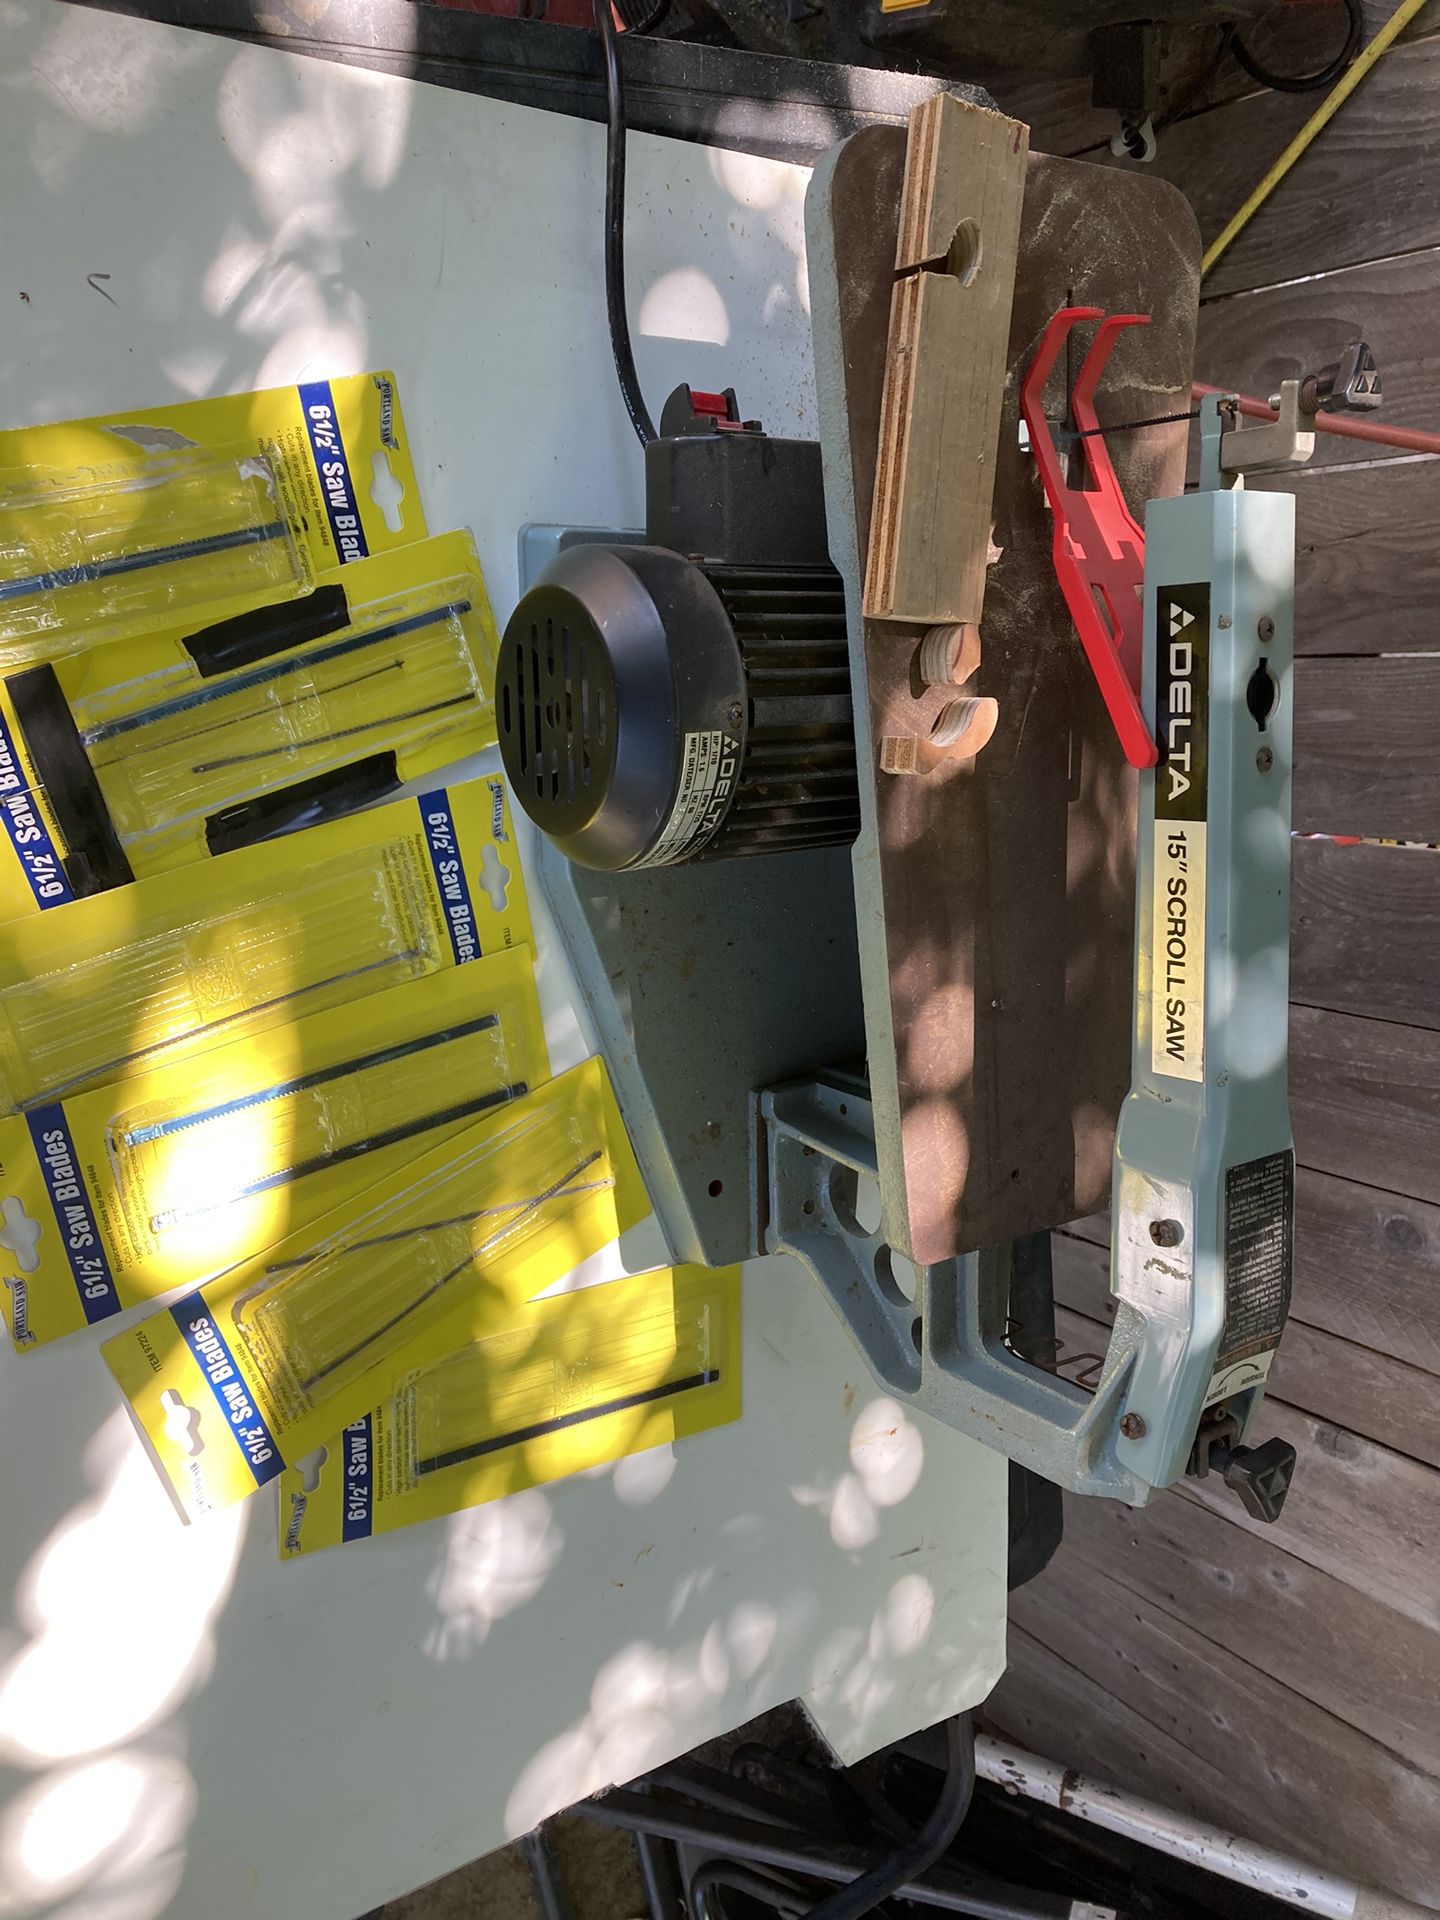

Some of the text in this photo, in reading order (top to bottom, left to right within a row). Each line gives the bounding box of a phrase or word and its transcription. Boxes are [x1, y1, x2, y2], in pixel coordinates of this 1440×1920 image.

[381, 384, 392, 443] PORTLAND SAW
[286, 433, 296, 452] Cuts
[290, 454, 298, 462] in
[294, 426, 310, 472] Replacement
[291, 463, 301, 478] any
[304, 474, 316, 497] blades
[322, 461, 349, 509] Saw
[297, 480, 311, 513] direction
[311, 498, 320, 508] for
[312, 510, 324, 525] Item
[1168, 642, 1192, 800] DELTA
[689, 737, 697, 756] MFG.
[700, 736, 708, 760] AMPS:
[683, 758, 696, 793] DATE/SER.
[494, 784, 504, 838] PORTLAND SAW
[697, 758, 736, 834] DELTA
[4, 795, 42, 844] Saw
[414, 832, 428, 873] Replacement
[423, 874, 433, 894] blades
[438, 860, 462, 900] Saw
[428, 894, 436, 903] for
[430, 904, 440, 917] Item
[448, 904, 475, 964] Blades
[502, 927, 511, 944] ITEM
[1164, 830, 1187, 1062] 15" SCROLL SAW
[42, 1129, 80, 1202] Blades
[92, 1184, 102, 1198] Item
[96, 1200, 106, 1210] for
[106, 1192, 122, 1222] direction
[64, 1206, 94, 1249] Saw
[100, 1210, 112, 1230] blades
[116, 1224, 126, 1238] any
[106, 1232, 124, 1272] Replacement
[124, 1246, 133, 1264] Cuts
[14, 1280, 28, 1340] PORTLAND SAW
[136, 1330, 162, 1372] ITEM 97224
[188, 1317, 234, 1384] Blades
[244, 1360, 254, 1373] Item
[250, 1373, 258, 1381] for
[254, 1382, 267, 1400] blades
[218, 1382, 254, 1424] Saw
[262, 1400, 282, 1435] Replacement
[348, 1436, 368, 1476] Saw
[287, 1513, 302, 1548] PORTLAND
